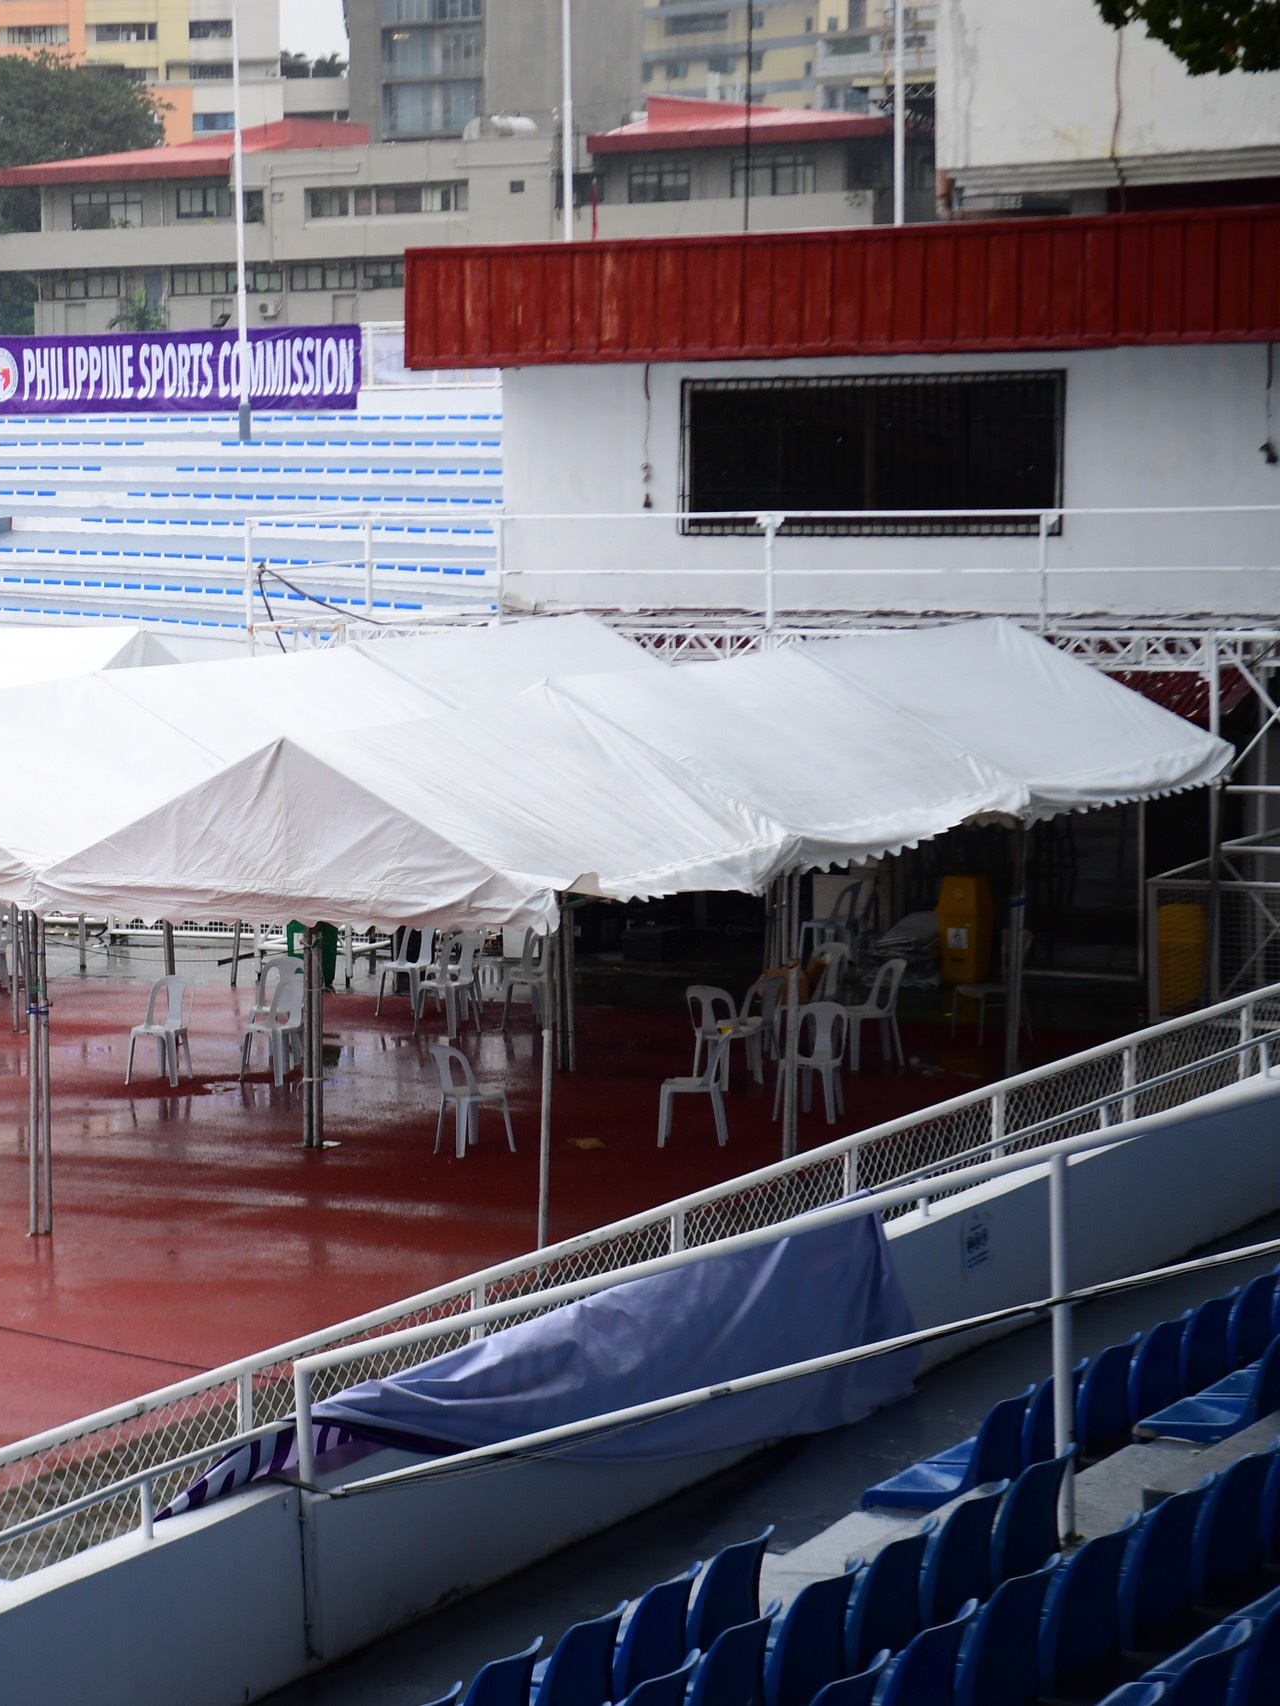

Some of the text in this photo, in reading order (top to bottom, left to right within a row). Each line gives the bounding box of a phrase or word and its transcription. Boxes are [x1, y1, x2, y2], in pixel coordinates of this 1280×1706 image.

[22, 345, 134, 401] PHILIPPINE
[137, 341, 214, 400] SPORTS
[218, 337, 354, 398] COMMISSION
